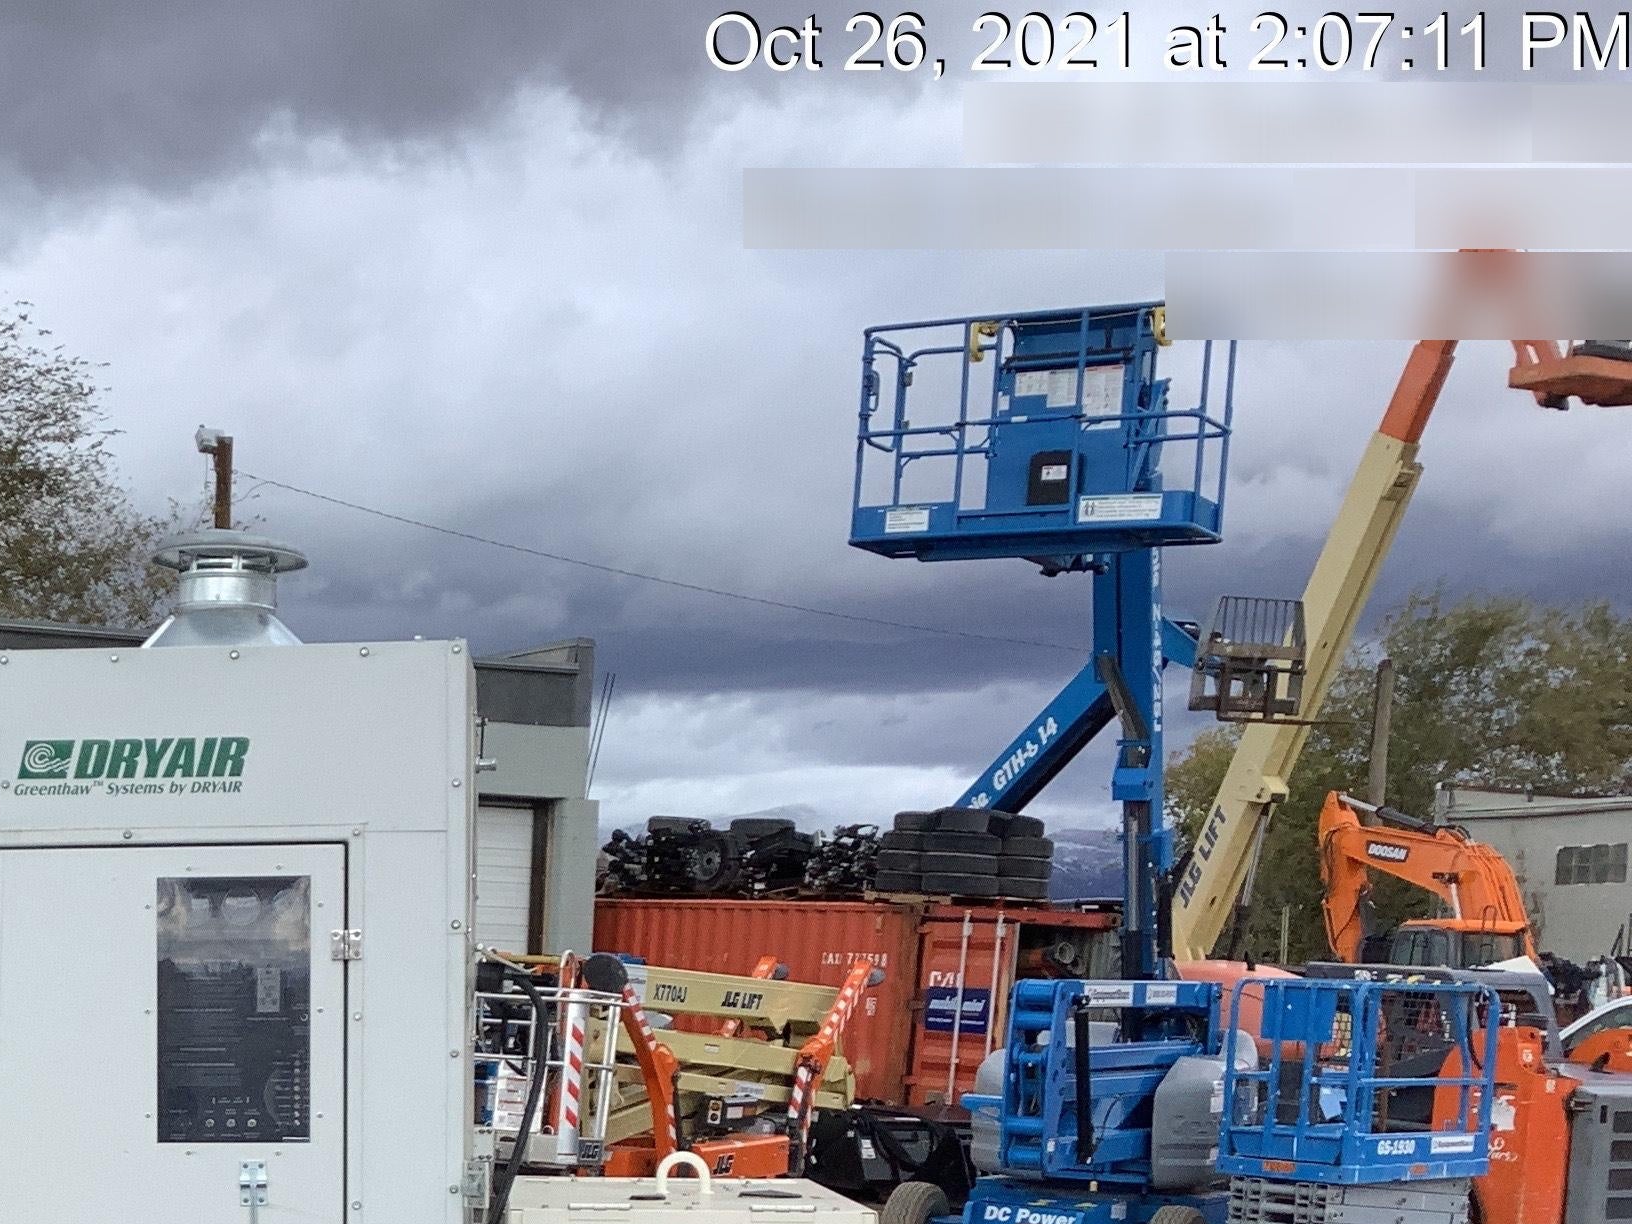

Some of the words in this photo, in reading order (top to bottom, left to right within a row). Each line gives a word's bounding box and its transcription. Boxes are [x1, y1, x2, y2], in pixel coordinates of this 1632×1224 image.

[73, 737, 250, 779] DRYAIR
[106, 781, 164, 796] Systems
[168, 781, 187, 796] by
[190, 780, 242, 794] DRYAIR
[1180, 861, 1203, 909] JLG
[1198, 804, 1226, 861] LIFT
[1368, 843, 1407, 860] DOOSAN
[721, 991, 741, 1008] JLG
[741, 992, 764, 1010] LIFT
[581, 1142, 599, 1160] JLG
[1377, 1139, 1416, 1156] GS-1930
[984, 1205, 1012, 1222] DC
